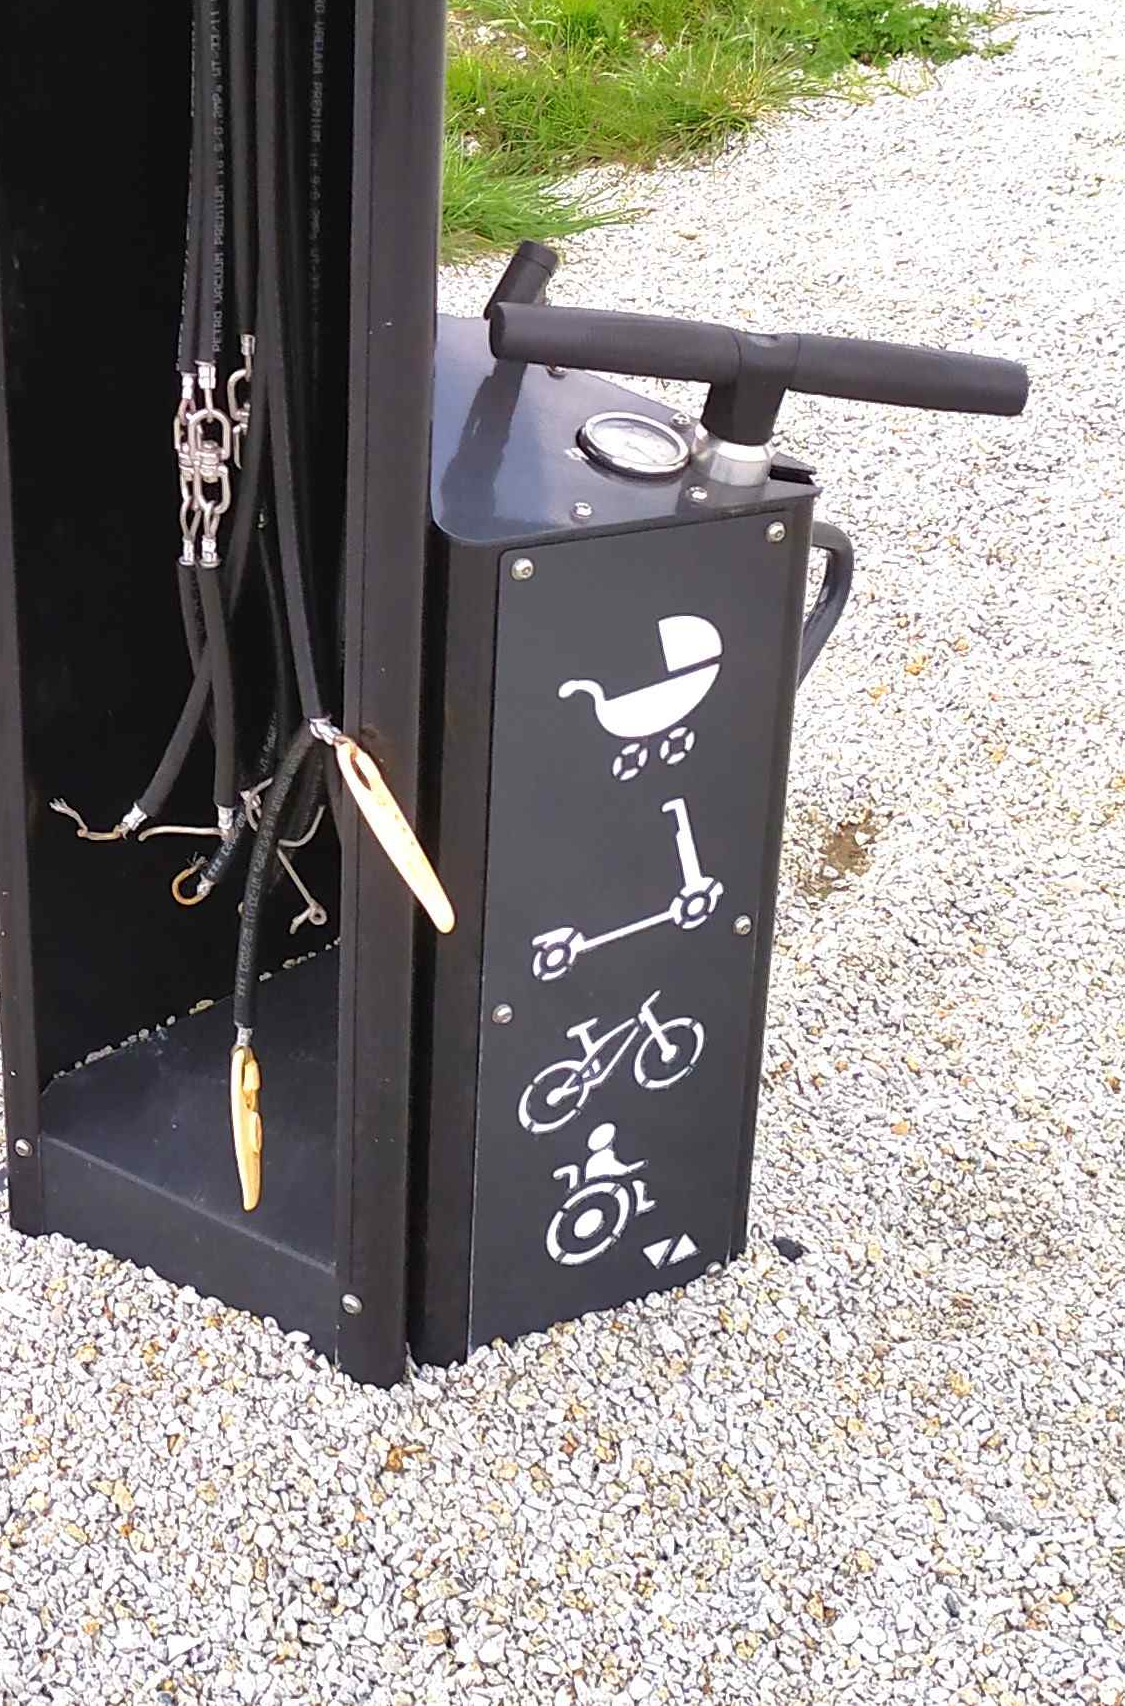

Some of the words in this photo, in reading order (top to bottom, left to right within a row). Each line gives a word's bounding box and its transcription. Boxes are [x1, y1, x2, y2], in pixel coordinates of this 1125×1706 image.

[212, 184, 224, 246] PREMIUM
[212, 252, 224, 304] VACUUM
[211, 310, 224, 352] PETRO
